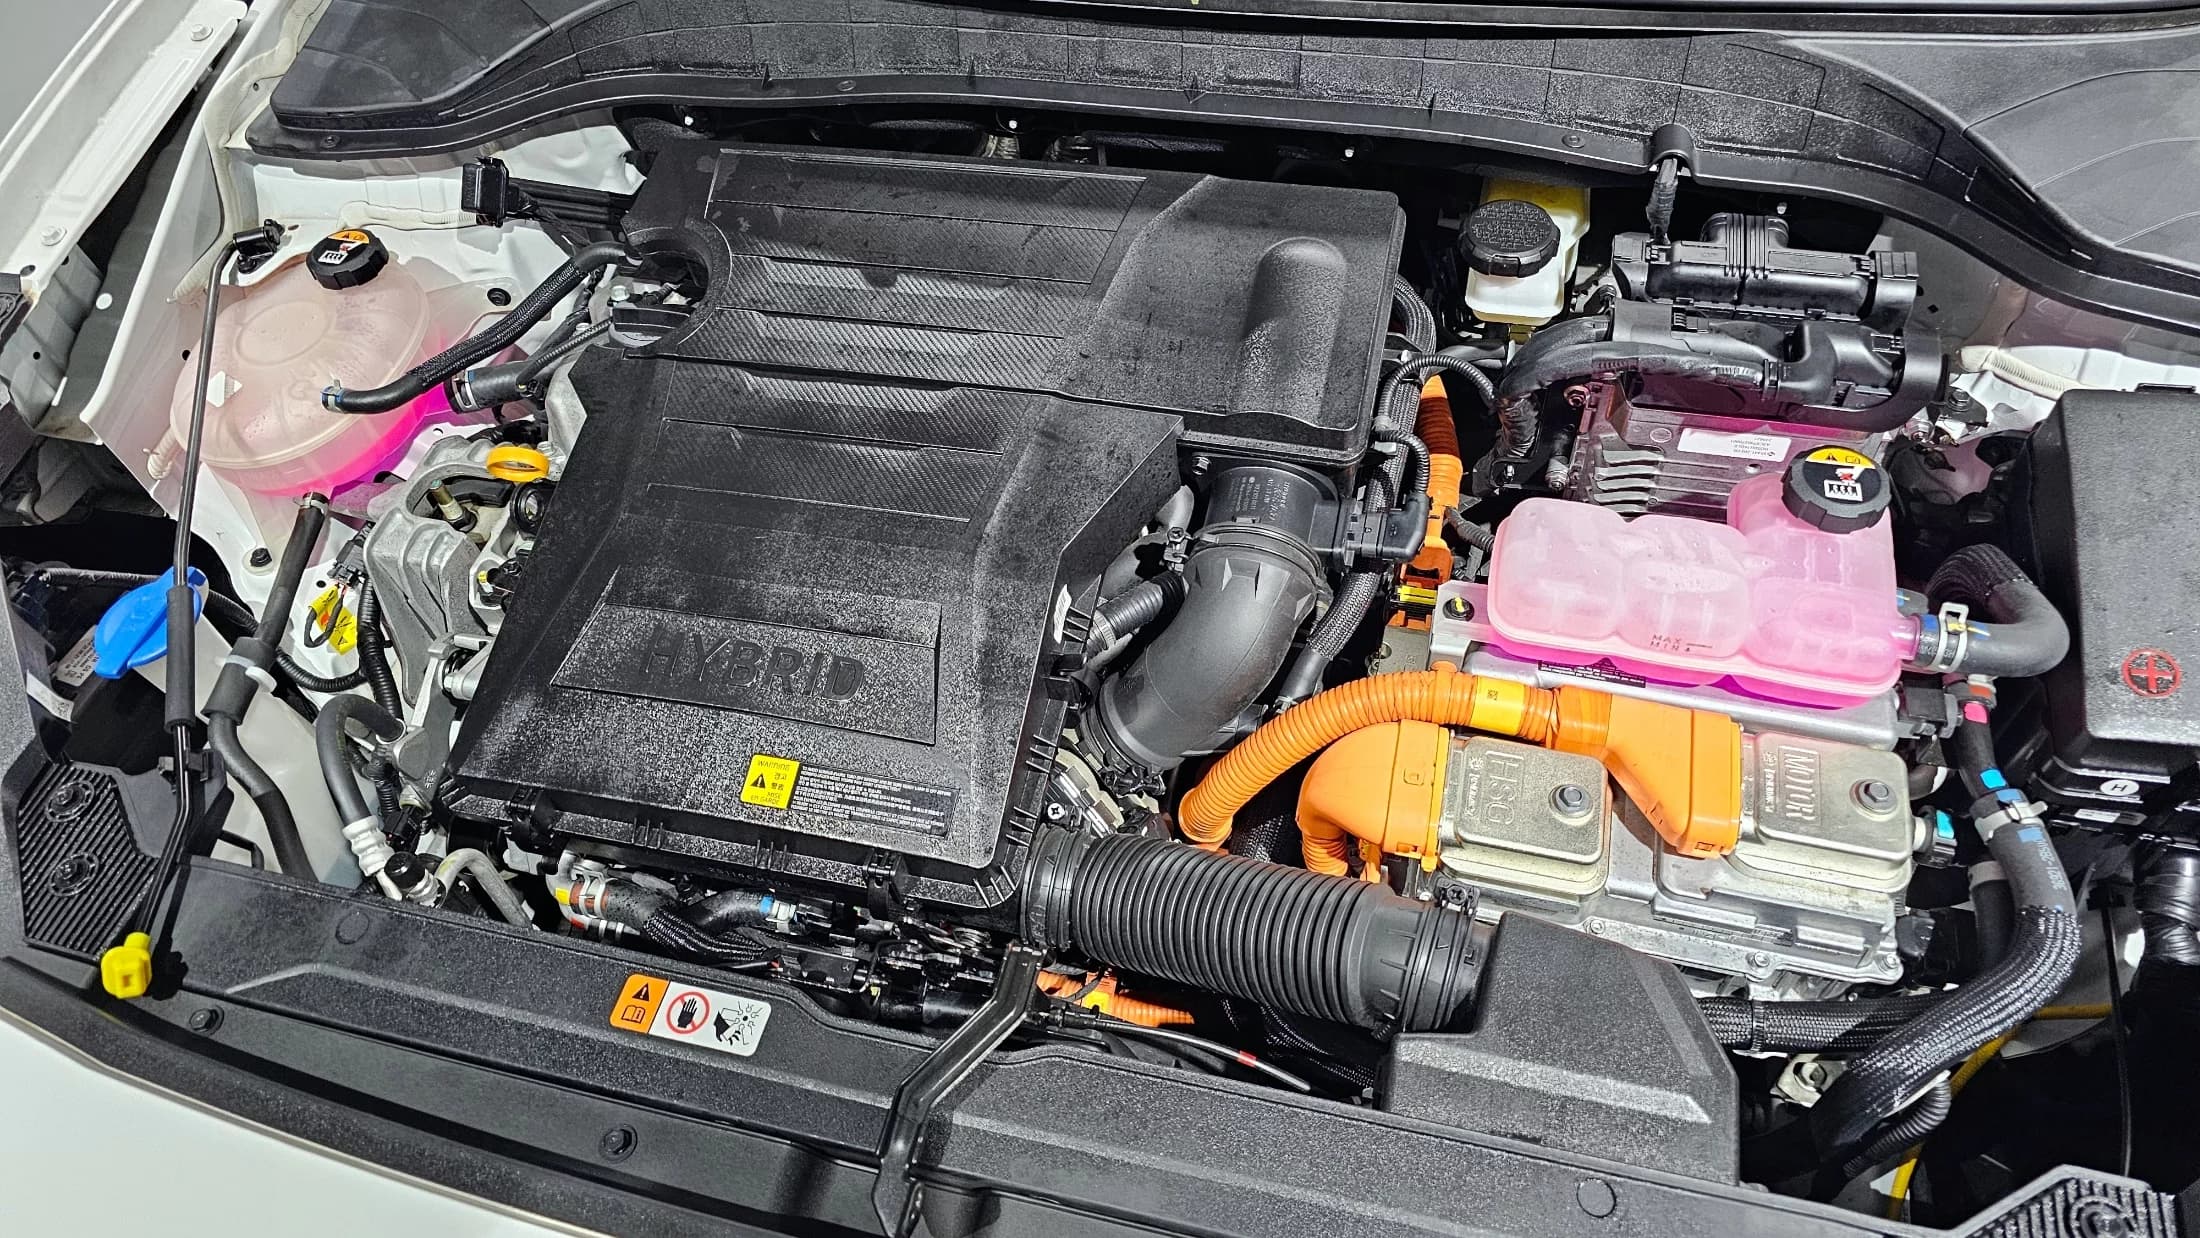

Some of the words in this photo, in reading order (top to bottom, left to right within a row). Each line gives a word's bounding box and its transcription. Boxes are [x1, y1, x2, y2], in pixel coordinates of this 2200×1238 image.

[640, 626, 864, 703] HYBRID
[1650, 640, 1680, 651] MIN
[1651, 633, 1682, 645] MAX
[1485, 759, 1519, 825] HSG
[1784, 753, 1816, 821] MOTOR
